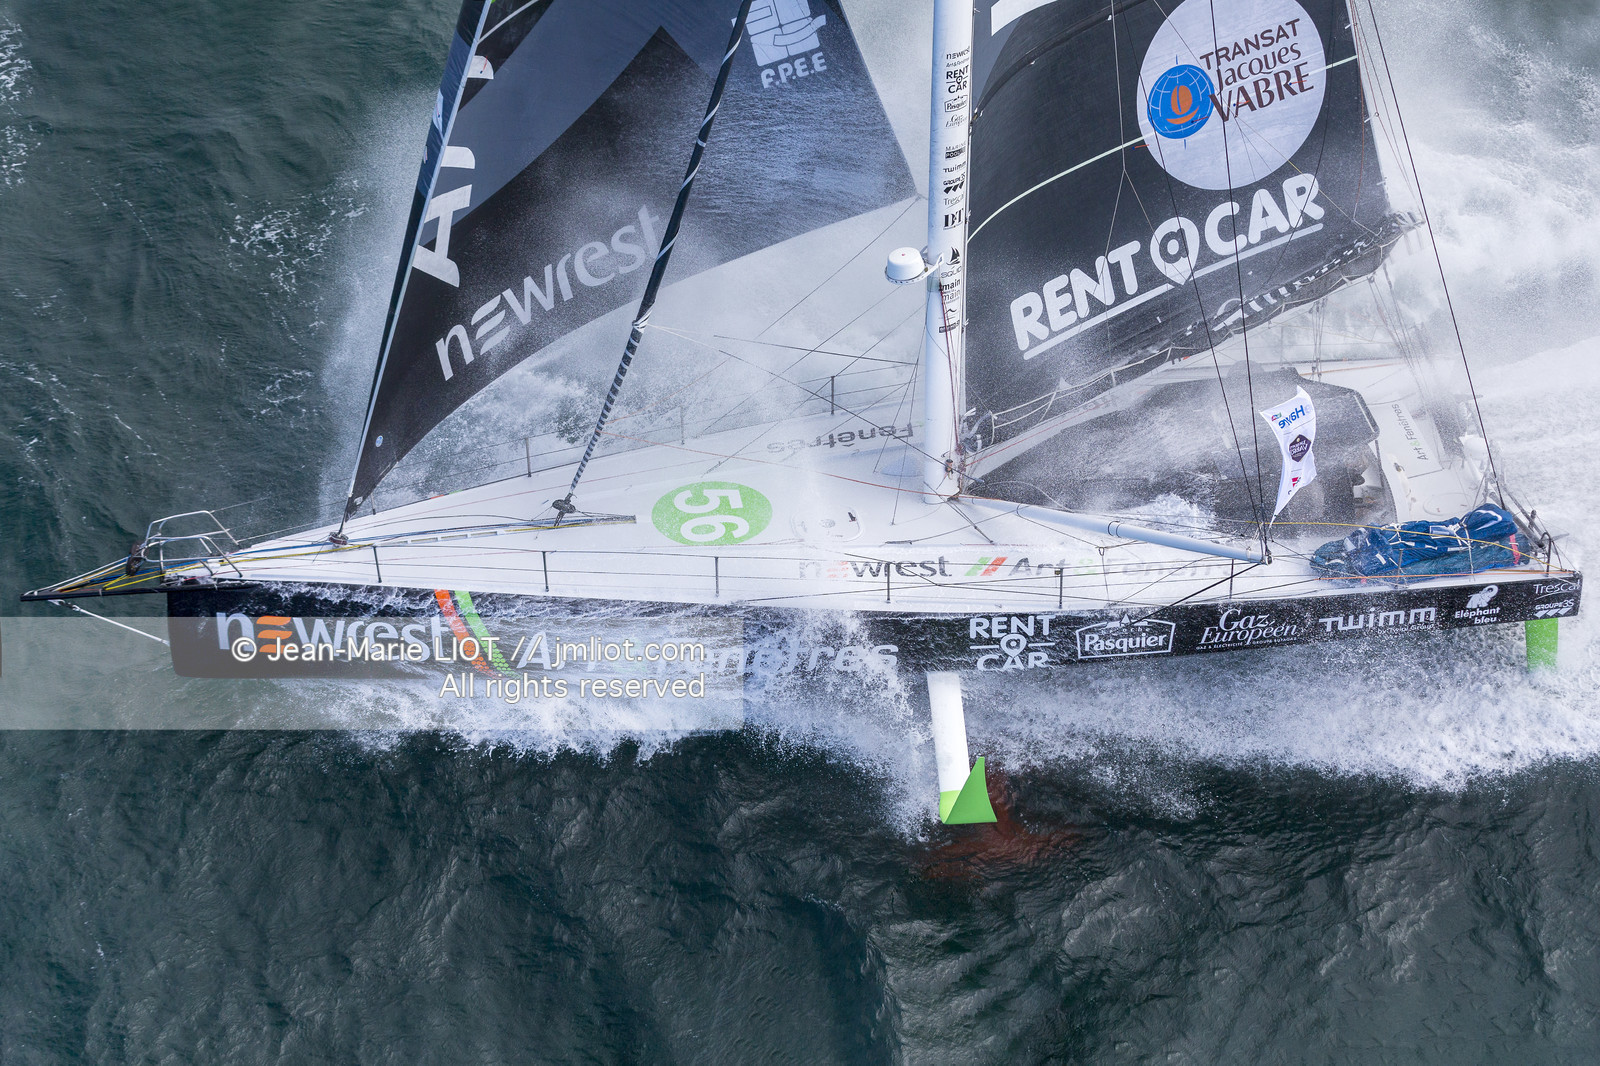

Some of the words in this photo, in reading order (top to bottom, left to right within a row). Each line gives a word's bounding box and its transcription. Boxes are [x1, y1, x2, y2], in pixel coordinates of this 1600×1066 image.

[1200, 18, 1300, 70] TRANSAT
[946, 65, 969, 80] RENT
[1216, 43, 1302, 96] Jacques
[948, 81, 967, 93] CAR
[1208, 62, 1314, 123] VABRE
[1010, 240, 1141, 351] RENT
[1204, 173, 1325, 256] CAR
[674, 488, 750, 543] 56
[970, 614, 1057, 639] RENT
[1219, 609, 1270, 631] Gaz
[1085, 632, 1168, 652] Pasquier
[976, 651, 1050, 671] CAR
